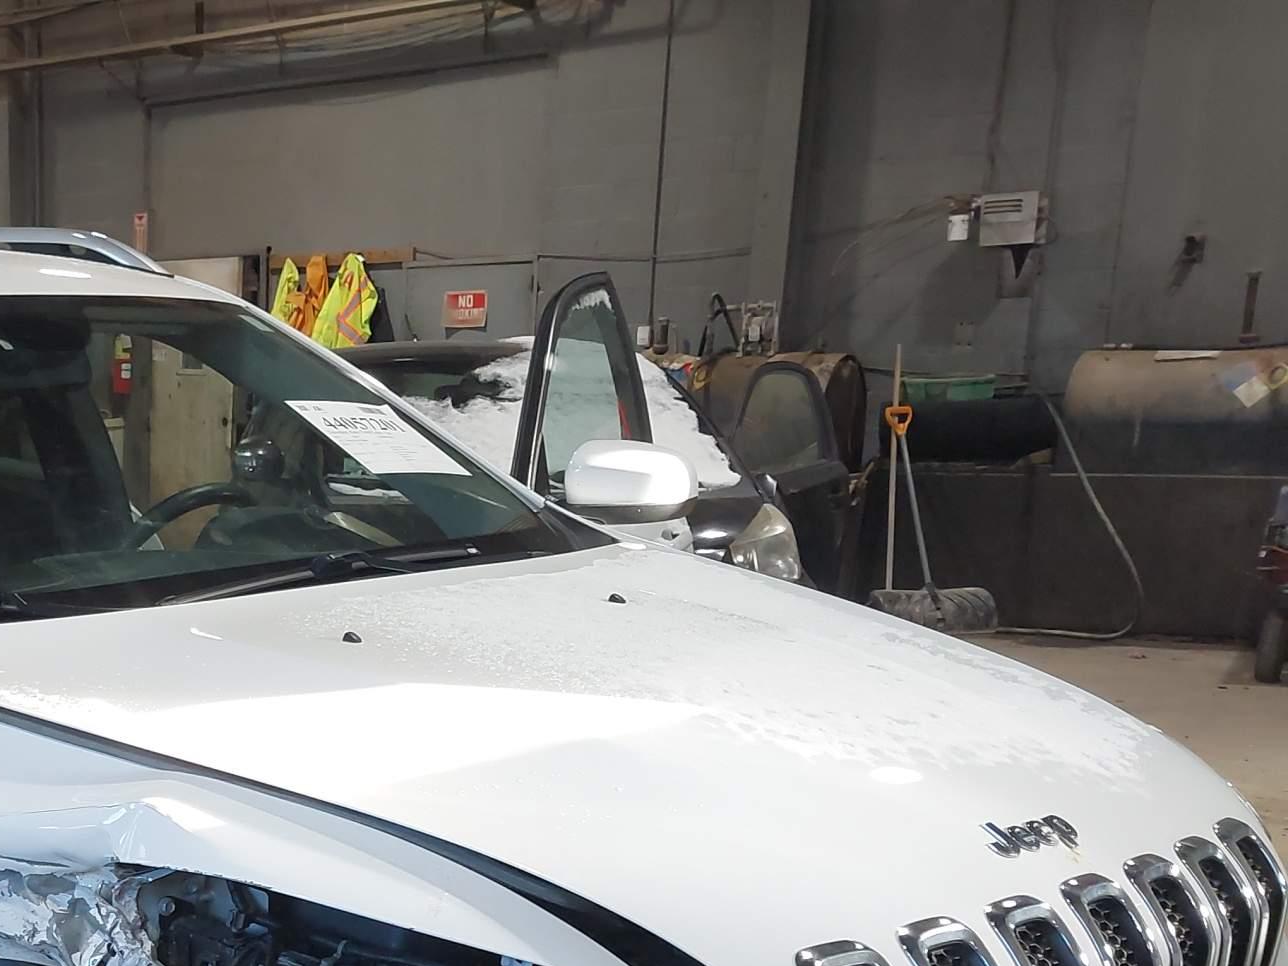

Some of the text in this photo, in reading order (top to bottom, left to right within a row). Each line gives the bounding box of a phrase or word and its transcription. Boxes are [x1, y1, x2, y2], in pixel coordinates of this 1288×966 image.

[458, 294, 473, 308] NO
[321, 416, 406, 433] 44057201
[979, 815, 1079, 858] Jeep
